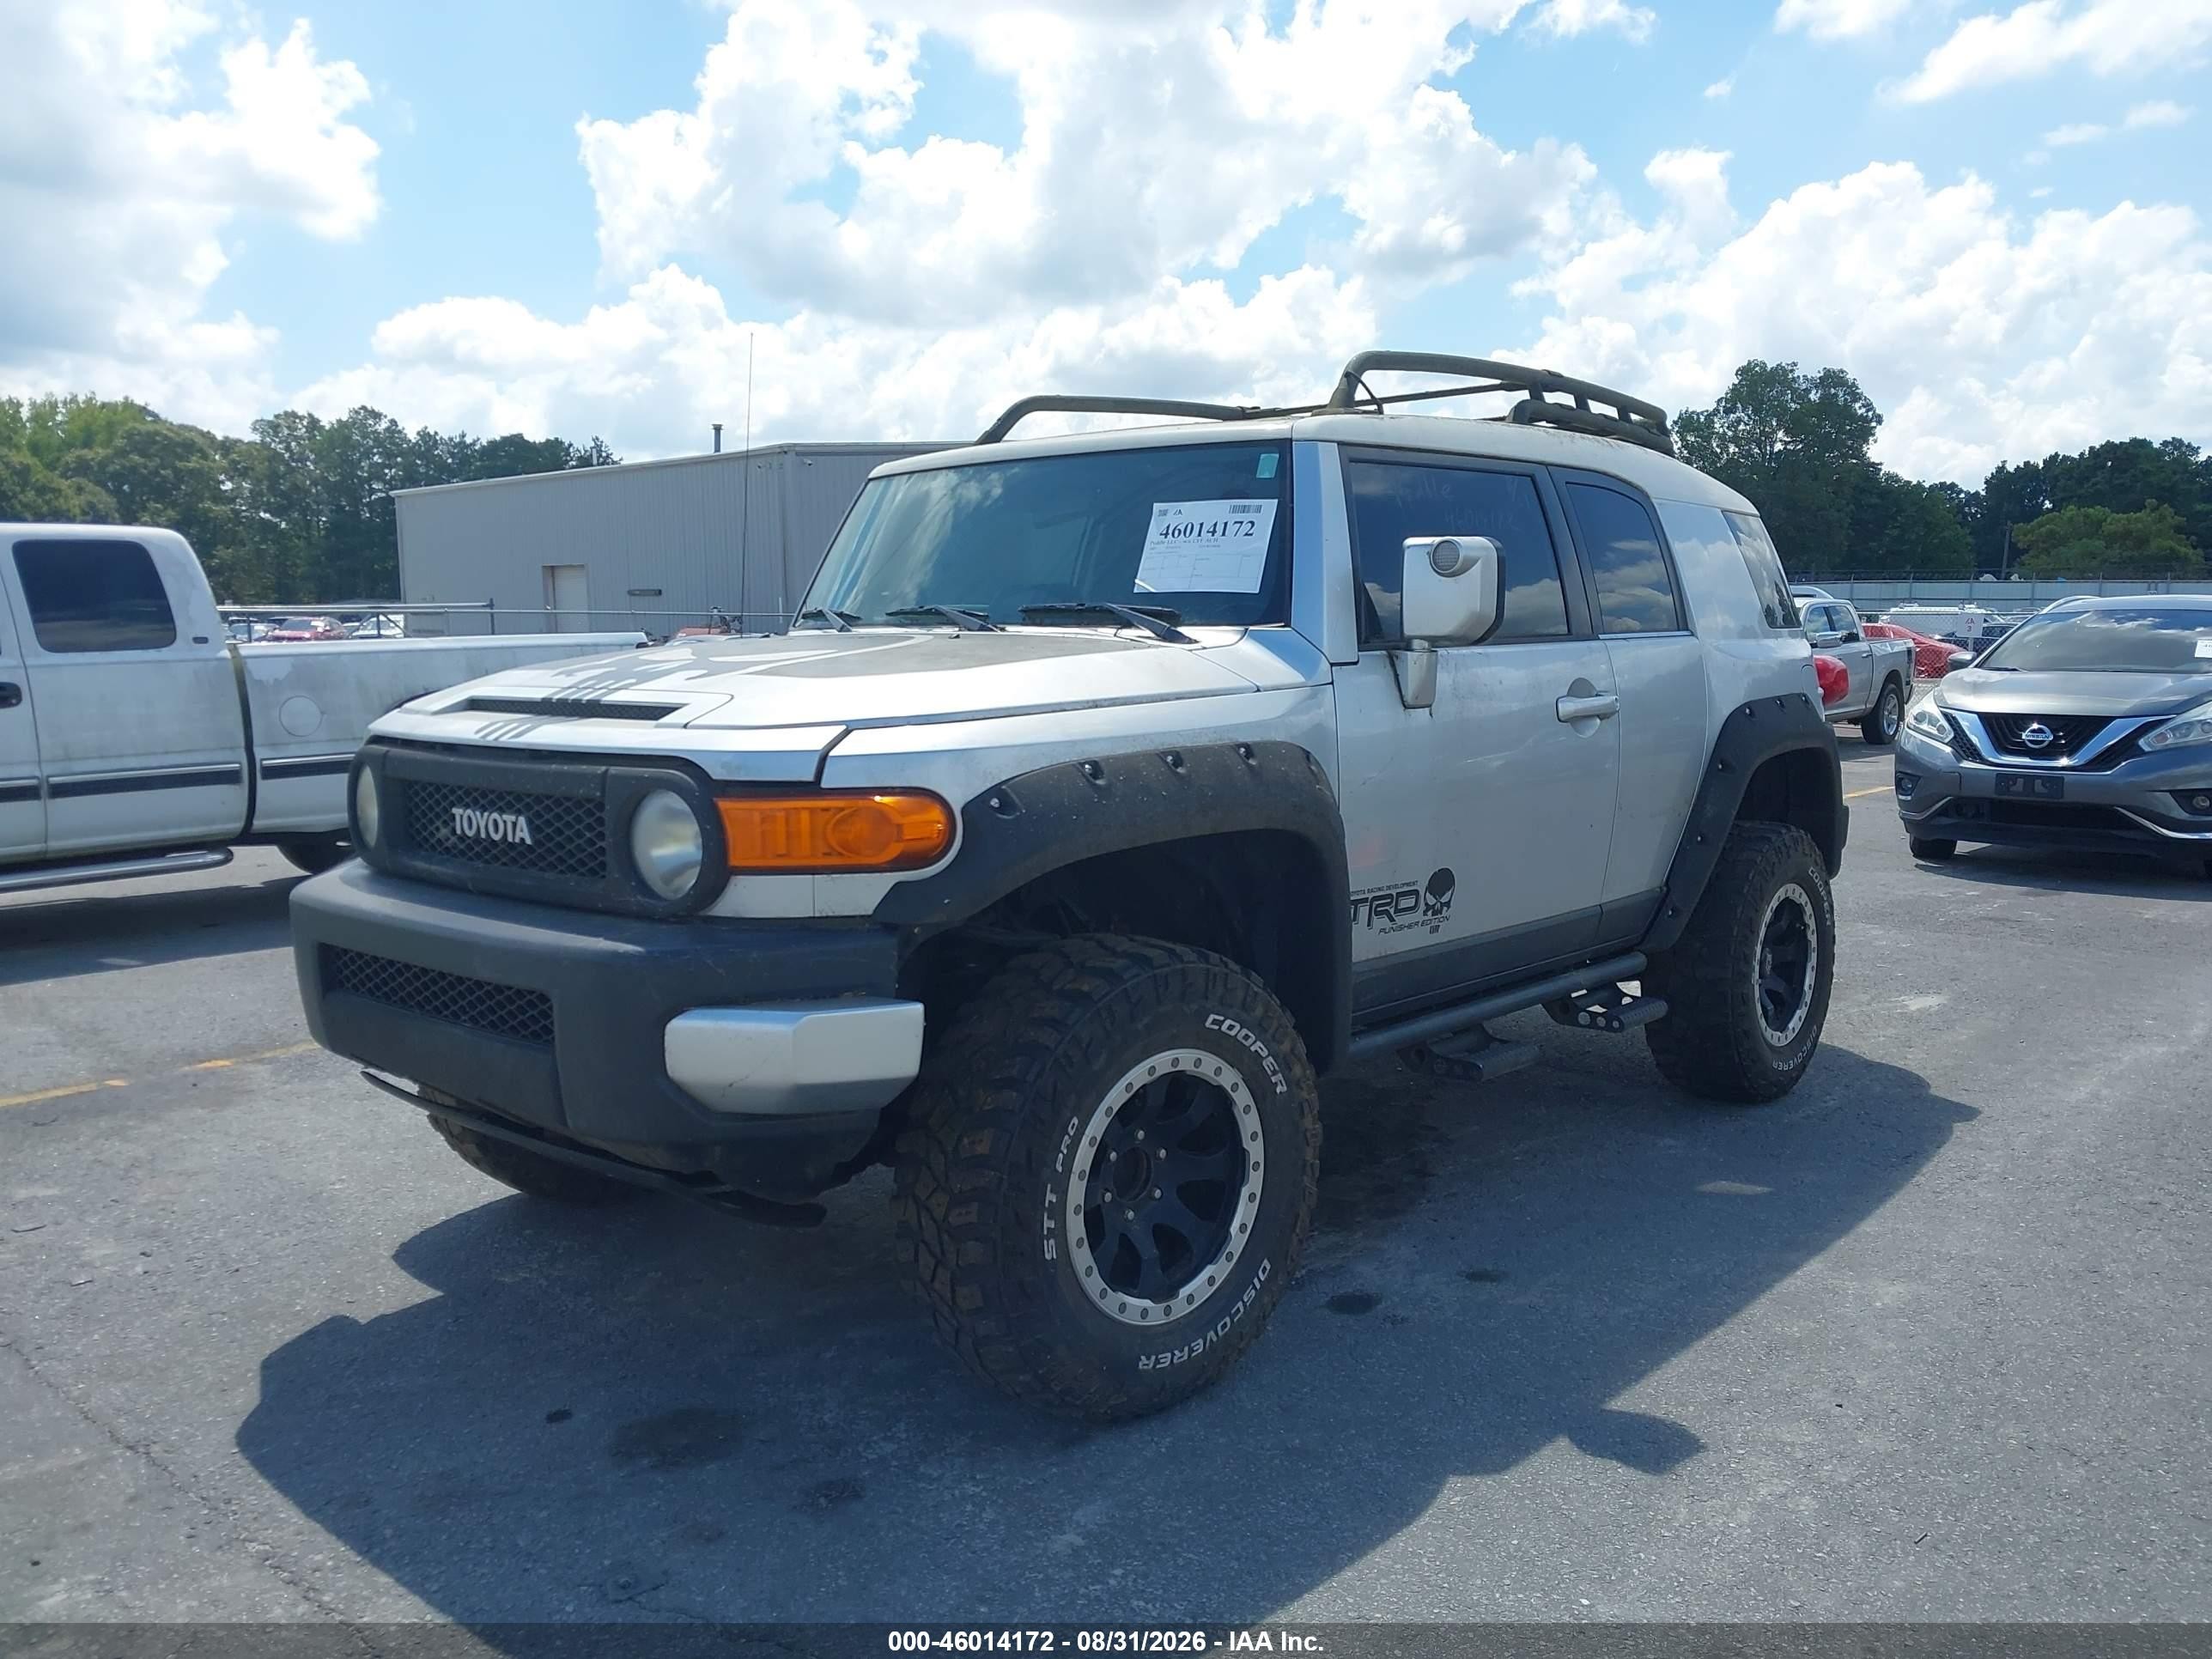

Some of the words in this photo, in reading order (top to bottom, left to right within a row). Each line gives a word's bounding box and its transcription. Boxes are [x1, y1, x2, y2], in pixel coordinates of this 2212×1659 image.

[1159, 520, 1255, 539] 46014172
[452, 807, 532, 845] TOYOTA
[1350, 889, 1422, 930] TRD
[1808, 866, 1832, 927] COOPER
[1378, 921, 1419, 935] PUNISHER
[1420, 915, 1451, 927] EDITION
[1204, 1013, 1288, 1095] COOPER
[1771, 1024, 1819, 1073] DISCOVERER
[1043, 1183, 1059, 1261] STT
[1055, 1115, 1079, 1176] PRO
[1138, 1258, 1272, 1370] DISCOVERER
